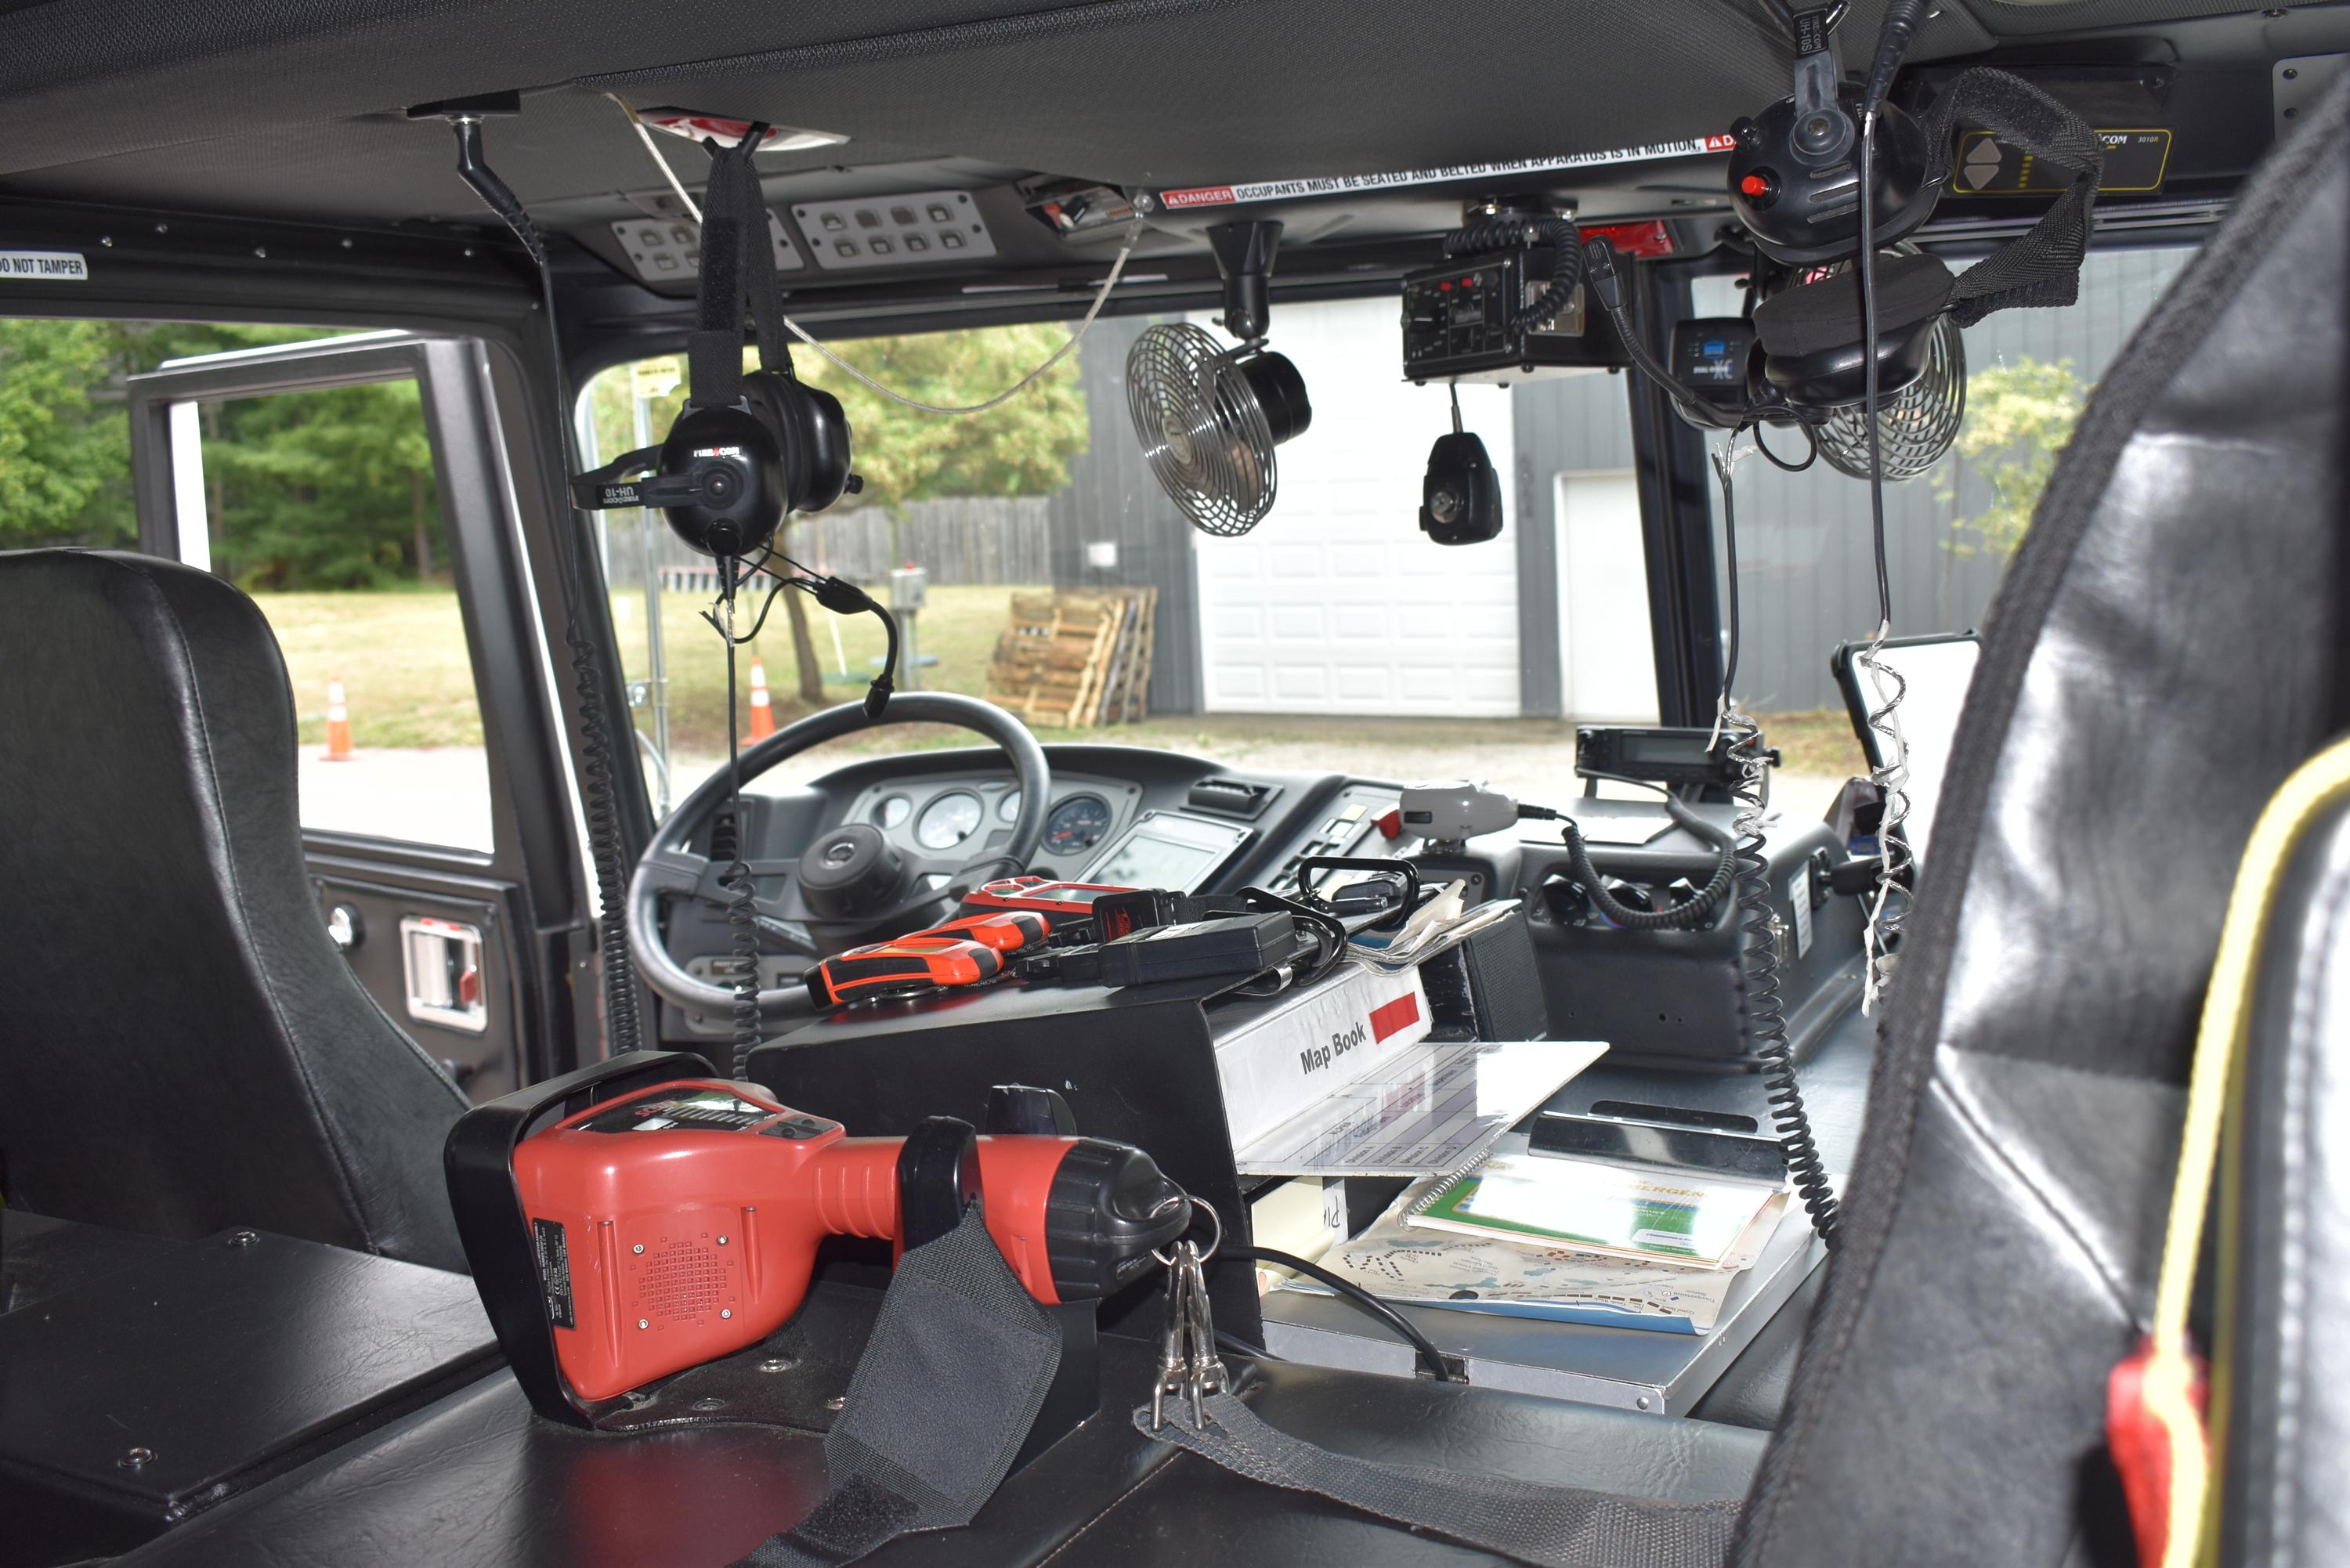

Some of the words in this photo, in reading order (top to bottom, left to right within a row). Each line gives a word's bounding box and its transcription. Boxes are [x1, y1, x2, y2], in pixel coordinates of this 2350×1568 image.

[1799, 18, 1813, 52] UH-10S
[2102, 135, 2128, 145] COM
[1179, 190, 1233, 204] DANGER
[1236, 182, 1306, 200] OCCUPANTS
[1307, 177, 1340, 192] MUST
[1343, 175, 1361, 188] BE
[1362, 169, 1408, 186] SEATED
[1411, 167, 1437, 181] AND
[1441, 161, 1487, 178] BELTED
[1490, 158, 1528, 172] WHEN
[1531, 150, 1607, 168] APPARATUS
[1610, 148, 1624, 159] IS
[1627, 146, 1642, 157] IN
[0, 258, 11, 273] O
[13, 258, 34, 273] NOT
[38, 258, 83, 275] TAMPER
[605, 486, 634, 497] UH-10
[1300, 1044, 1332, 1075] Map
[1332, 1021, 1367, 1057] Book
[1323, 1194, 1340, 1229] Pl
